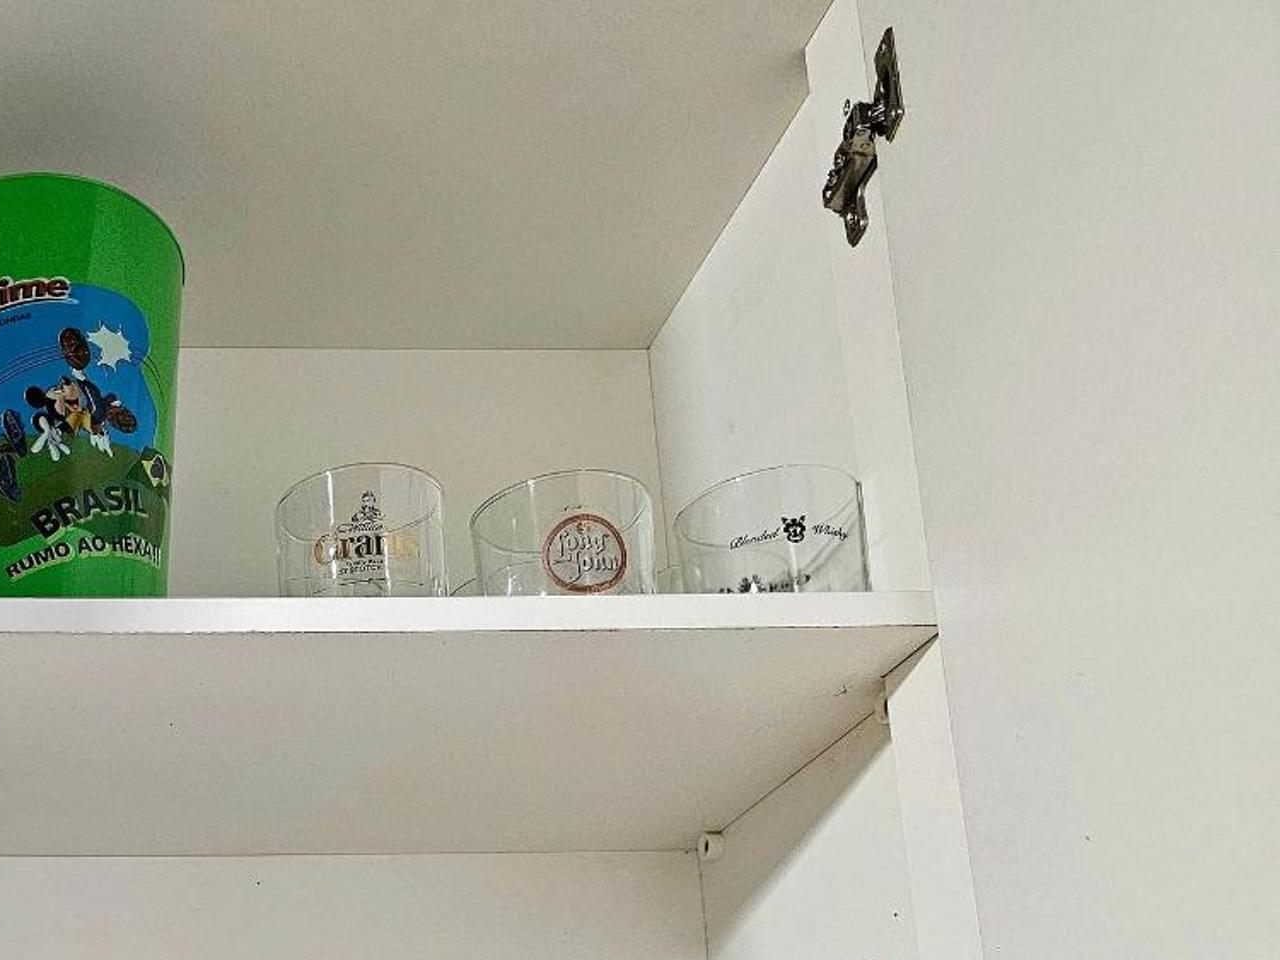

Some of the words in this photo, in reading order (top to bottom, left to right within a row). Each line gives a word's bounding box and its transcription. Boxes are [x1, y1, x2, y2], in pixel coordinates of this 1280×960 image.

[30, 484, 149, 544] BRASIL
[5, 542, 72, 582] RUMO
[78, 536, 107, 557] AO
